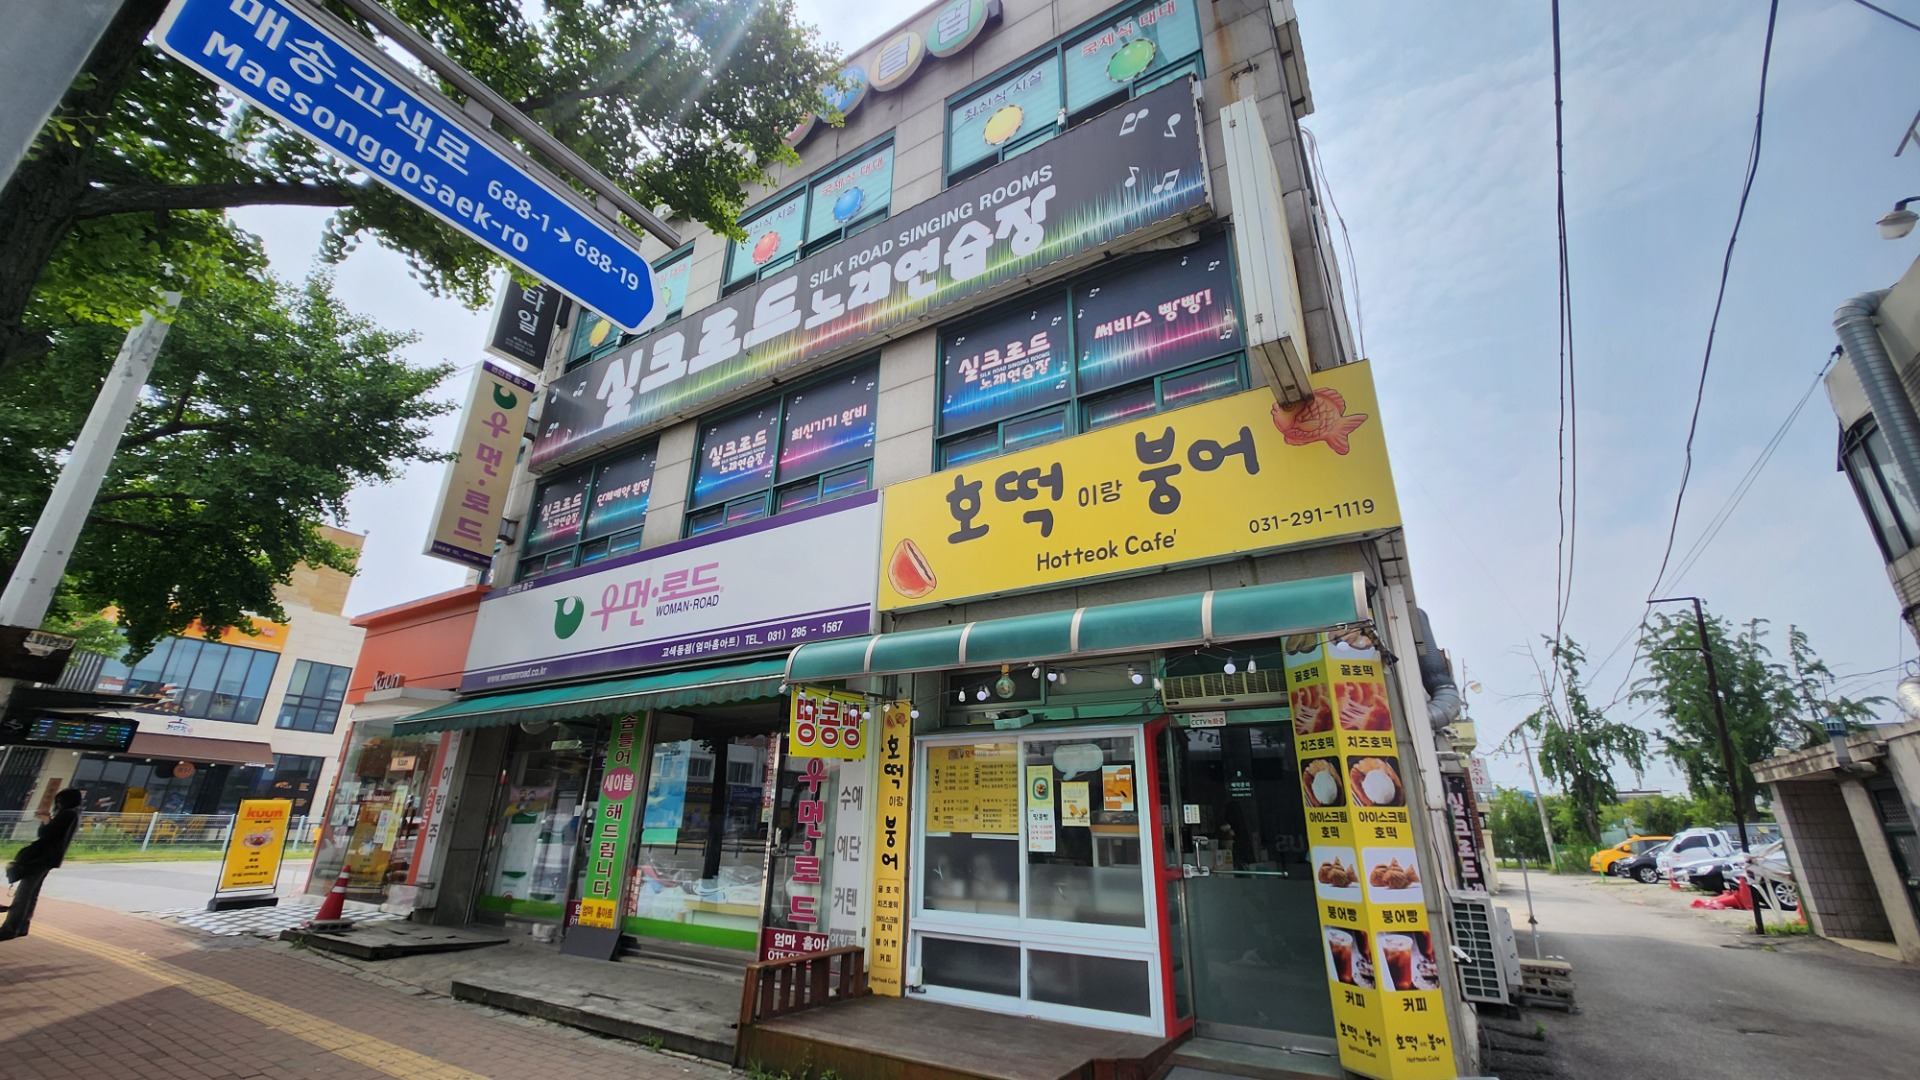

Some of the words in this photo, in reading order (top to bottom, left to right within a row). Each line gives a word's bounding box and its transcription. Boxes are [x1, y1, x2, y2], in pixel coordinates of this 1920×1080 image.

[1082, 22, 1134, 55] 국제식
[1139, 1, 1177, 29] 대대
[229, 0, 469, 177] 매송고색로
[1012, 69, 1043, 94] 시설
[202, 30, 529, 254] Maesonggosaek-ro
[486, 179, 550, 233] 688-1
[574, 238, 640, 292] 688-19
[809, 260, 843, 290] SILK
[848, 239, 893, 275] ROAD
[897, 206, 973, 249] SINGING
[979, 164, 1053, 210] ROOMS
[596, 274, 802, 429] 실크로드
[804, 185, 1057, 331] 노래연습장
[1094, 310, 1152, 339] 써비스
[1158, 288, 1212, 322] 빵빵!
[958, 331, 1051, 384] 실크로드
[980, 357, 1051, 391] 노래연습장
[791, 416, 837, 441] 최신기기
[841, 404, 867, 426] 완비
[708, 429, 767, 467] 실크로드
[945, 460, 1065, 546] 호떡
[1077, 480, 1124, 510] 이랑
[1134, 425, 1260, 516] 붕어
[541, 493, 582, 522] 실크로드
[1248, 497, 1376, 535] 031-291-1119
[1036, 540, 1119, 573] Hotteok
[821, 620, 843, 634] 1567
[1294, 667, 1319, 683] 꿀호떡
[1340, 664, 1374, 677] 꿀호떡
[795, 697, 865, 750] 땅콩빵
[1300, 736, 1335, 751] 치즈호떡
[1347, 735, 1393, 749] 치즈호떡
[884, 734, 903, 789] 호떡
[1309, 811, 1348, 824] 아이스크림
[1358, 811, 1407, 824] 아이스크림
[881, 815, 898, 870] 붕어
[1321, 826, 1340, 840] 호떡
[1374, 826, 1398, 840] 호떡
[837, 835, 861, 862] 예단
[834, 886, 857, 916] 커텐
[1327, 905, 1357, 922] 붕어빵
[1382, 909, 1418, 924] 붕어빵
[774, 932, 797, 949] 엄마
[1344, 990, 1366, 1008] 커피
[1403, 998, 1428, 1012] 커피
[1396, 1034, 1418, 1051] 호떡
[1427, 1033, 1446, 1051] 붕어
